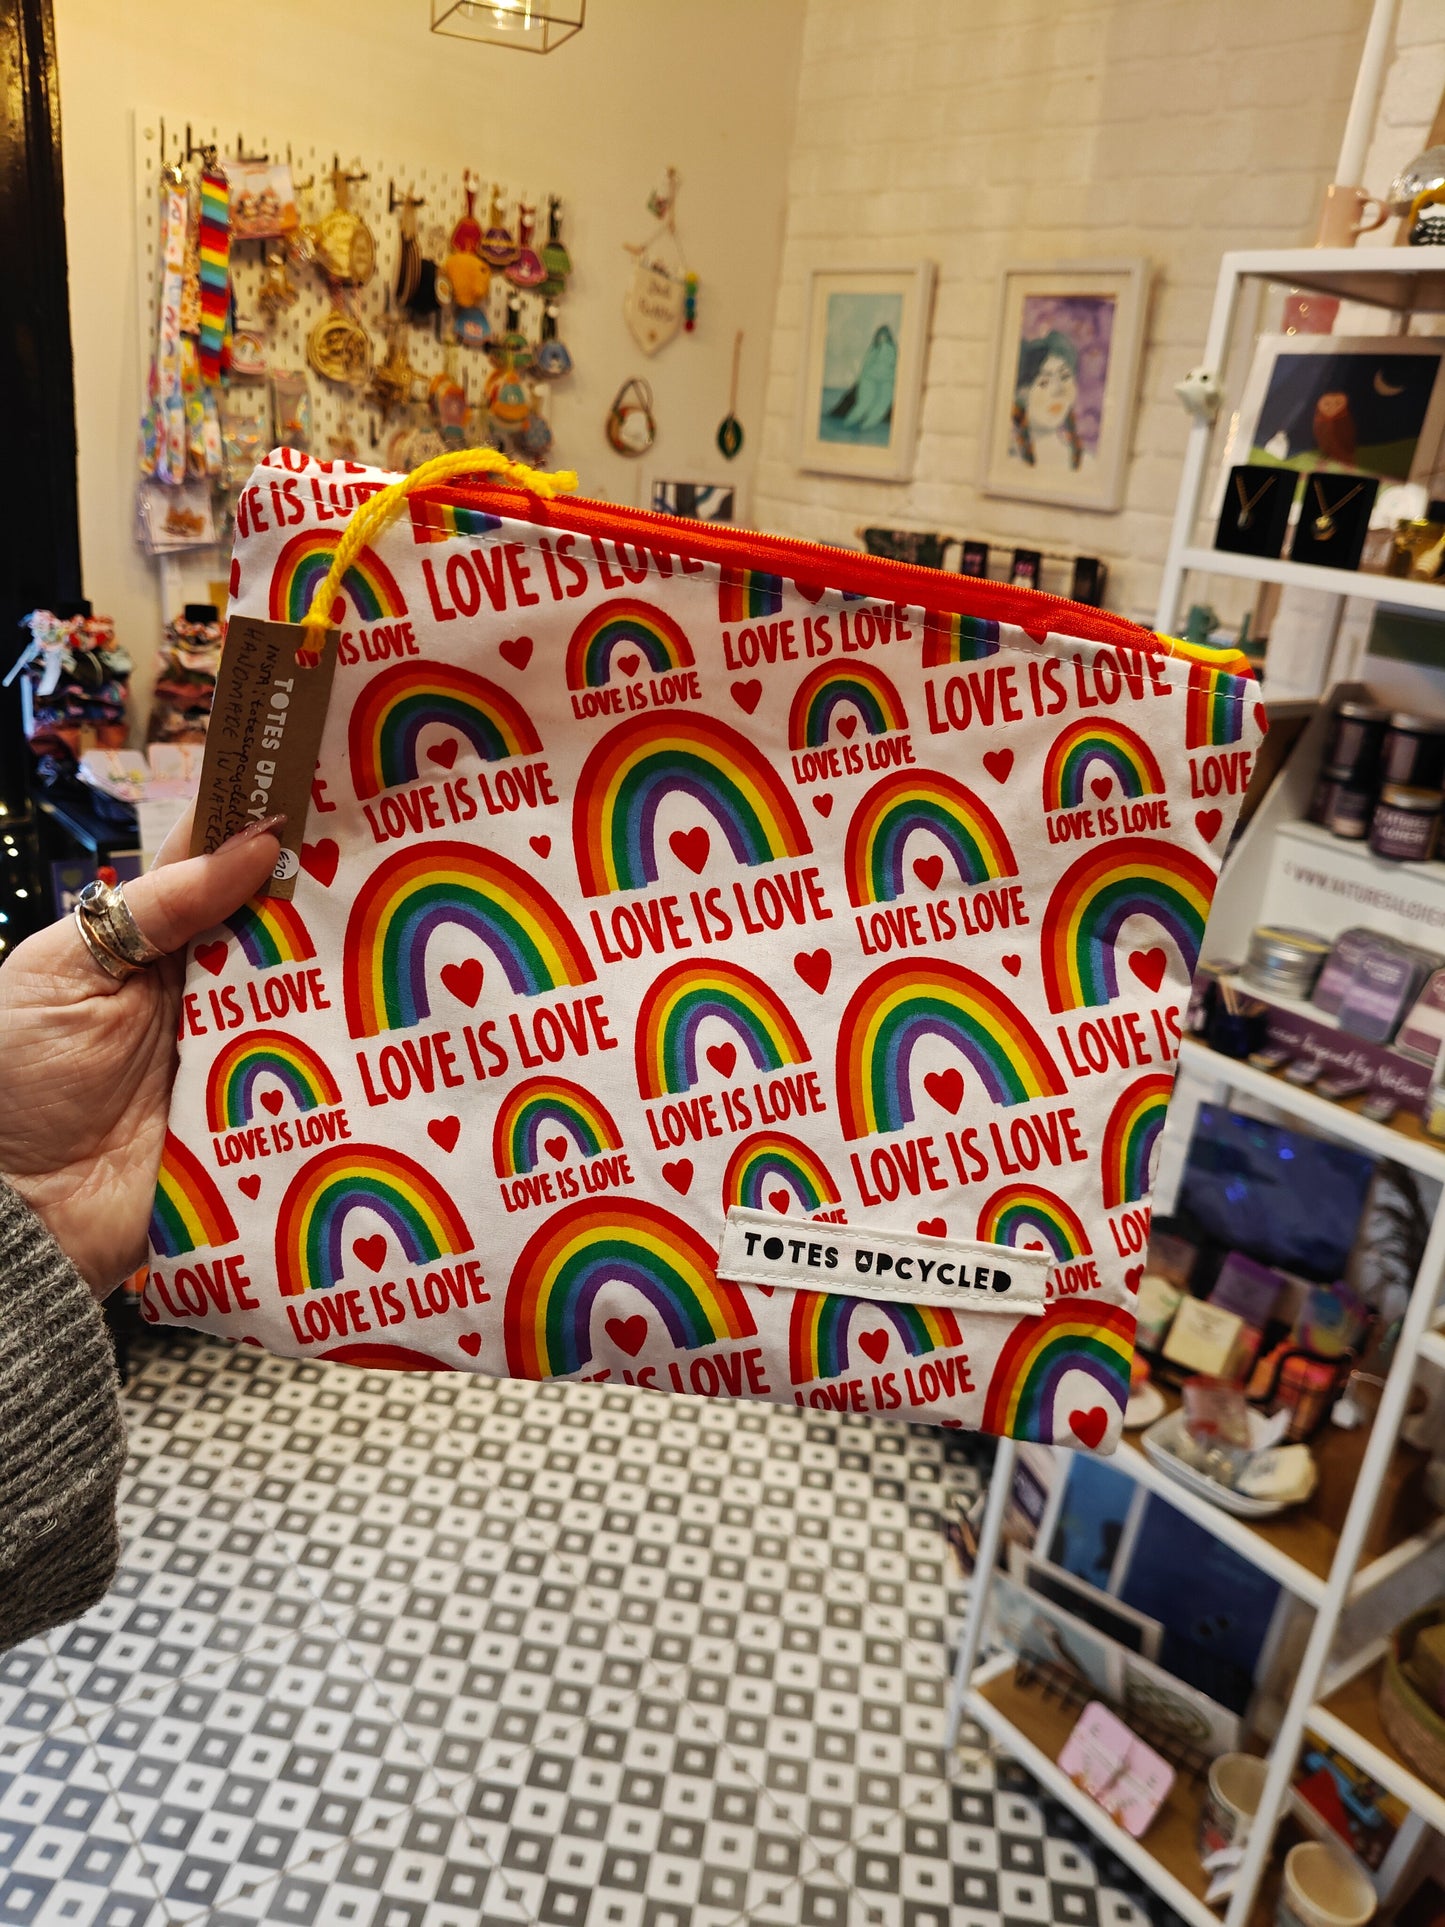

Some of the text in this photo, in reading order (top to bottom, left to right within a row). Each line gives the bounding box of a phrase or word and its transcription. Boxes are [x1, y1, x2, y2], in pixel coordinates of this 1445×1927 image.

[270, 479, 304, 526] IS
[422, 542, 539, 621] LOVE
[539, 535, 588, 600] IS
[359, 623, 419, 662] LOVE
[723, 604, 912, 670] LOVE IS LOVE
[261, 678, 294, 750] TOTES
[571, 672, 702, 719] LOVE IS LOVE
[925, 649, 1171, 734] LOVE IS LOVE
[792, 735, 915, 784] LOVE IS LOVE
[1190, 752, 1251, 798] LOVE
[363, 786, 445, 843] LOVE
[444, 778, 477, 823] IS
[478, 763, 558, 814] LOVE
[1047, 801, 1170, 844] LOVE IS LOVE
[590, 868, 832, 963] LOVE IS LOVE
[856, 886, 1029, 955] LOVE IS LOVE
[209, 986, 243, 1030] IS
[248, 969, 330, 1022] LOVE
[357, 996, 617, 1106] LOVE IS LOVE
[1058, 1007, 1182, 1077] LOVE IS
[213, 1109, 351, 1166] LOVE IS LOVE
[646, 1072, 826, 1150] LOVE IS LOVE
[501, 1155, 634, 1212] LOVE IS LOVE
[851, 1109, 1087, 1206] LOVE IS LOVE
[153, 1255, 260, 1315] LOVE
[745, 1232, 838, 1268] TOTES
[855, 1250, 1012, 1292] UPCYCLED
[1055, 1262, 1101, 1295] LOVE
[287, 1261, 490, 1344] LOVE IS LOVE
[872, 1373, 901, 1410] IS
[905, 1355, 975, 1406] LOVE
